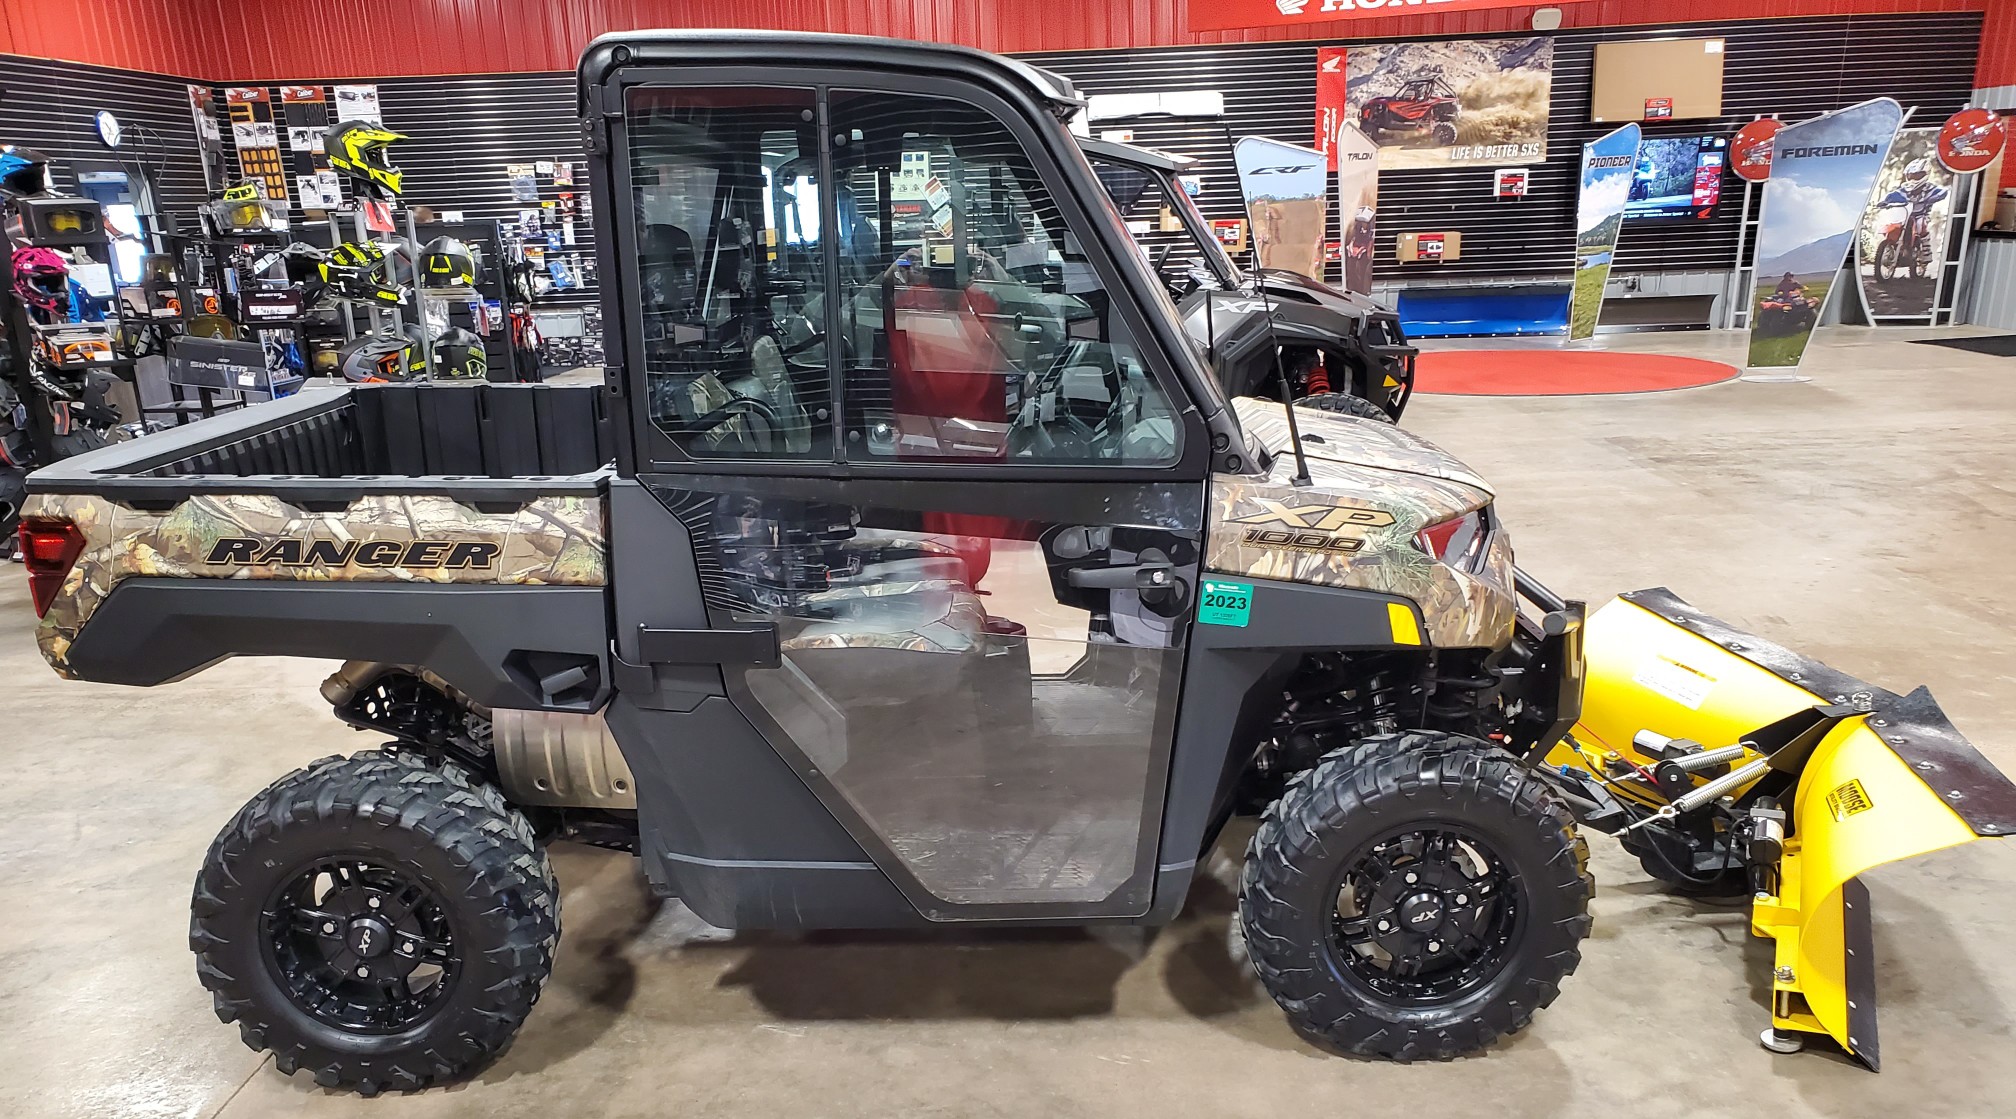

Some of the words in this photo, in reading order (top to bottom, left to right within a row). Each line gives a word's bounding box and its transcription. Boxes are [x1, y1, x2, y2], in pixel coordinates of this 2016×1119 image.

[242, 90, 258, 100] Caliber
[297, 89, 314, 99] Caliber
[1347, 153, 1373, 161] TALON
[1451, 147, 1471, 160] LIFE
[1473, 146, 1483, 159] IS
[1485, 144, 1519, 158] BETTER
[1521, 142, 1540, 157] SXS
[1781, 144, 1878, 159] FOREMAN
[1588, 155, 1632, 169] PIONEER
[1248, 165, 1317, 175] CRF
[1213, 300, 1279, 314] XP
[190, 361, 248, 373] SINISTER
[1219, 497, 1398, 532] XP
[1243, 529, 1366, 552] 1000
[205, 537, 502, 569] RANGER
[1204, 594, 1247, 610] 2023
[1836, 782, 1867, 814] MOOSE
[1411, 907, 1440, 924] XP
[358, 929, 371, 954] XP
